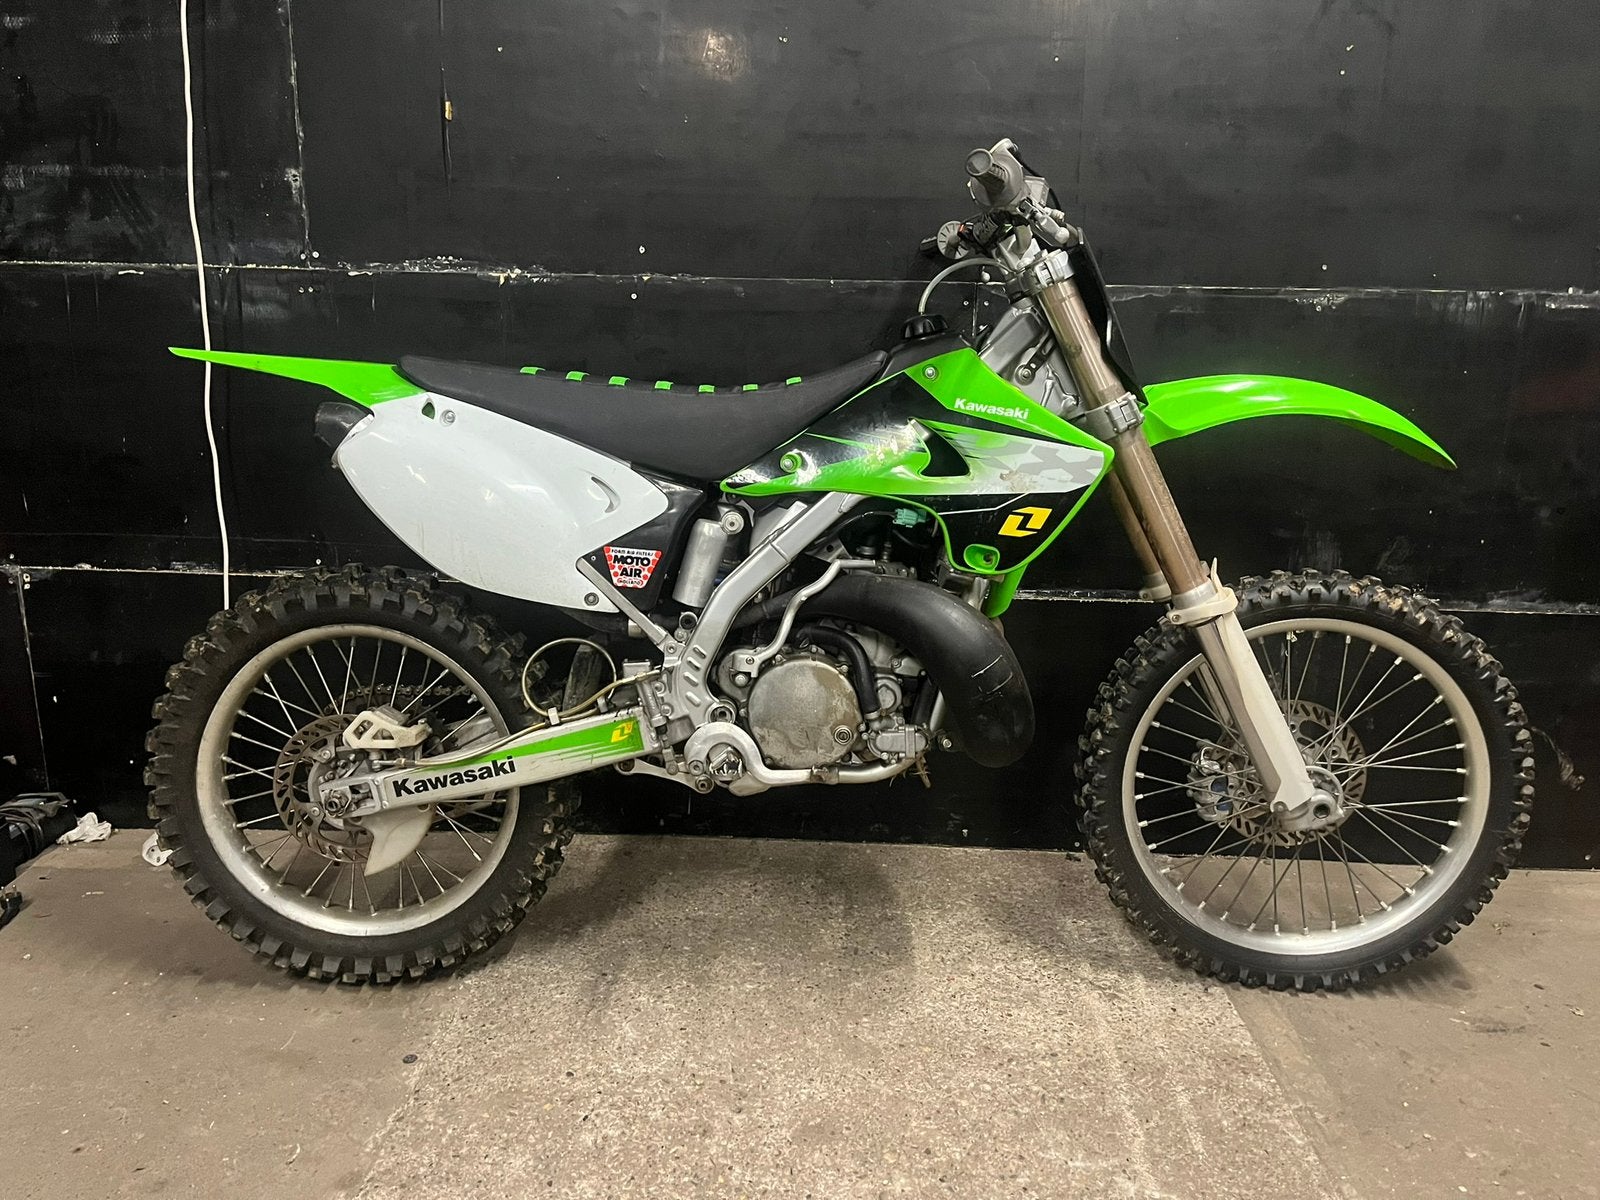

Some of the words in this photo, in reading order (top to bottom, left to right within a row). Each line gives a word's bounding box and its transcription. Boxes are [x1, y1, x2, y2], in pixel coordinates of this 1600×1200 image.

[954, 398, 1030, 420] Kawasaki
[613, 555, 651, 566] MOTO
[620, 567, 642, 578] AIR
[392, 755, 517, 798] Kawasaki
